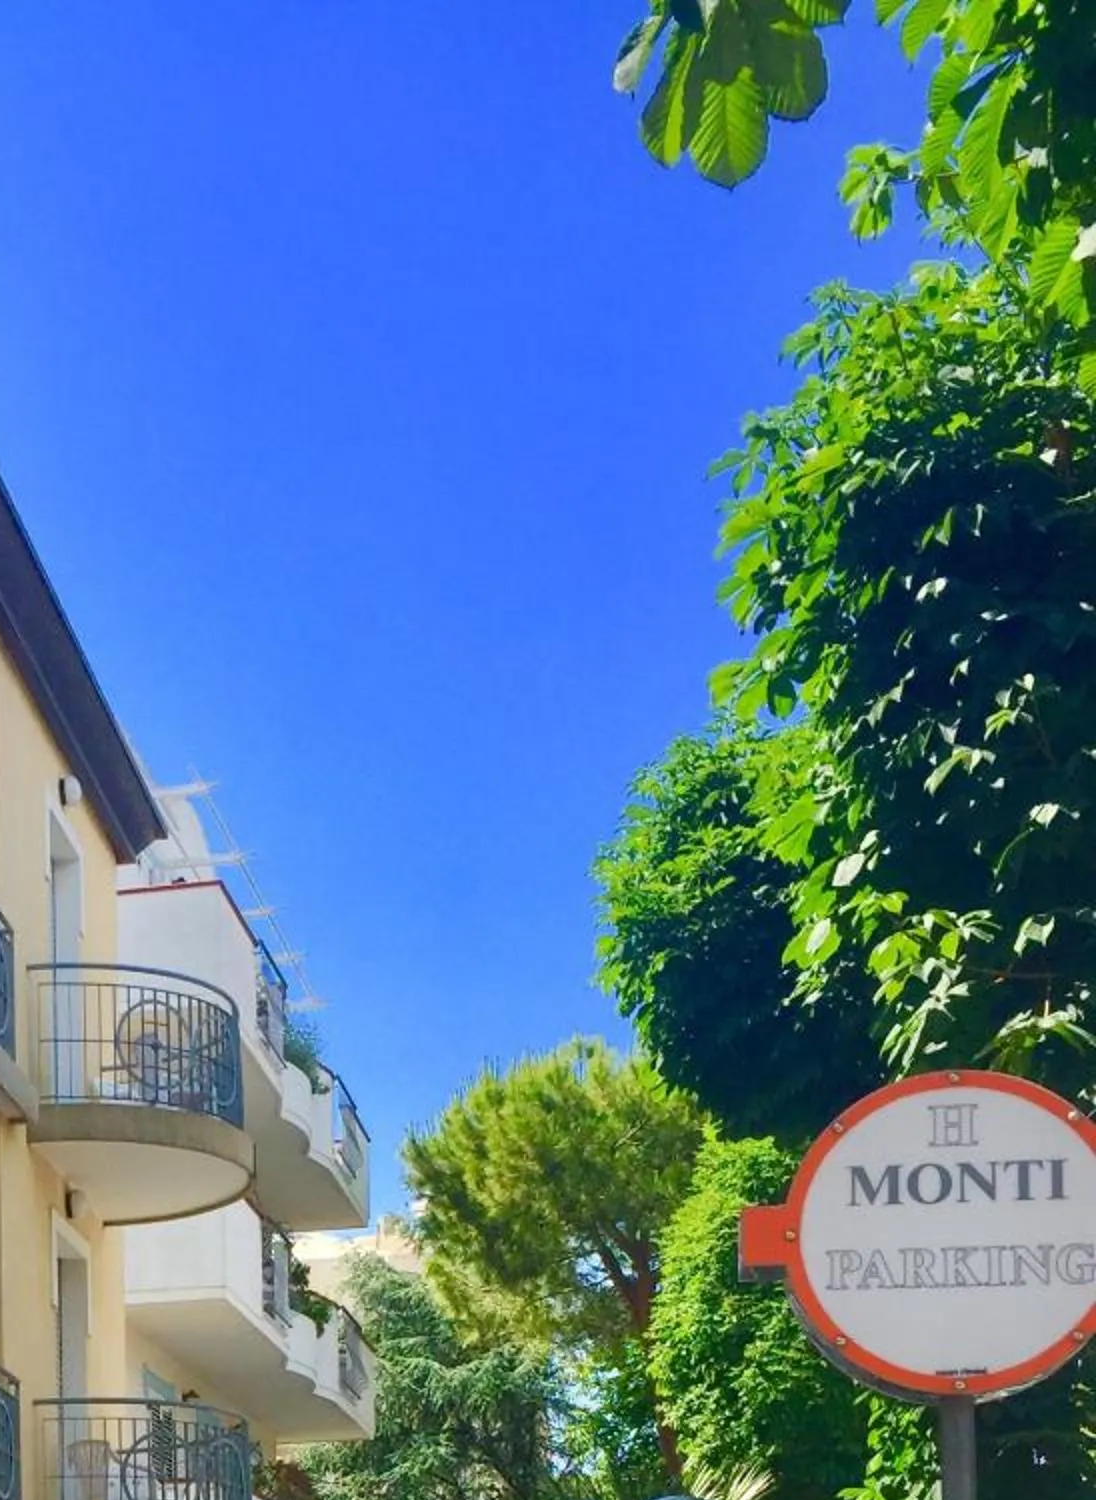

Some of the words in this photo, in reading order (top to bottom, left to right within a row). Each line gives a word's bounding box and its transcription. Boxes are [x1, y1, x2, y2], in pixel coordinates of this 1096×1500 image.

[927, 1103, 978, 1147] H
[847, 1158, 1070, 1206] MONTI
[825, 1243, 1096, 1290] PARKING
